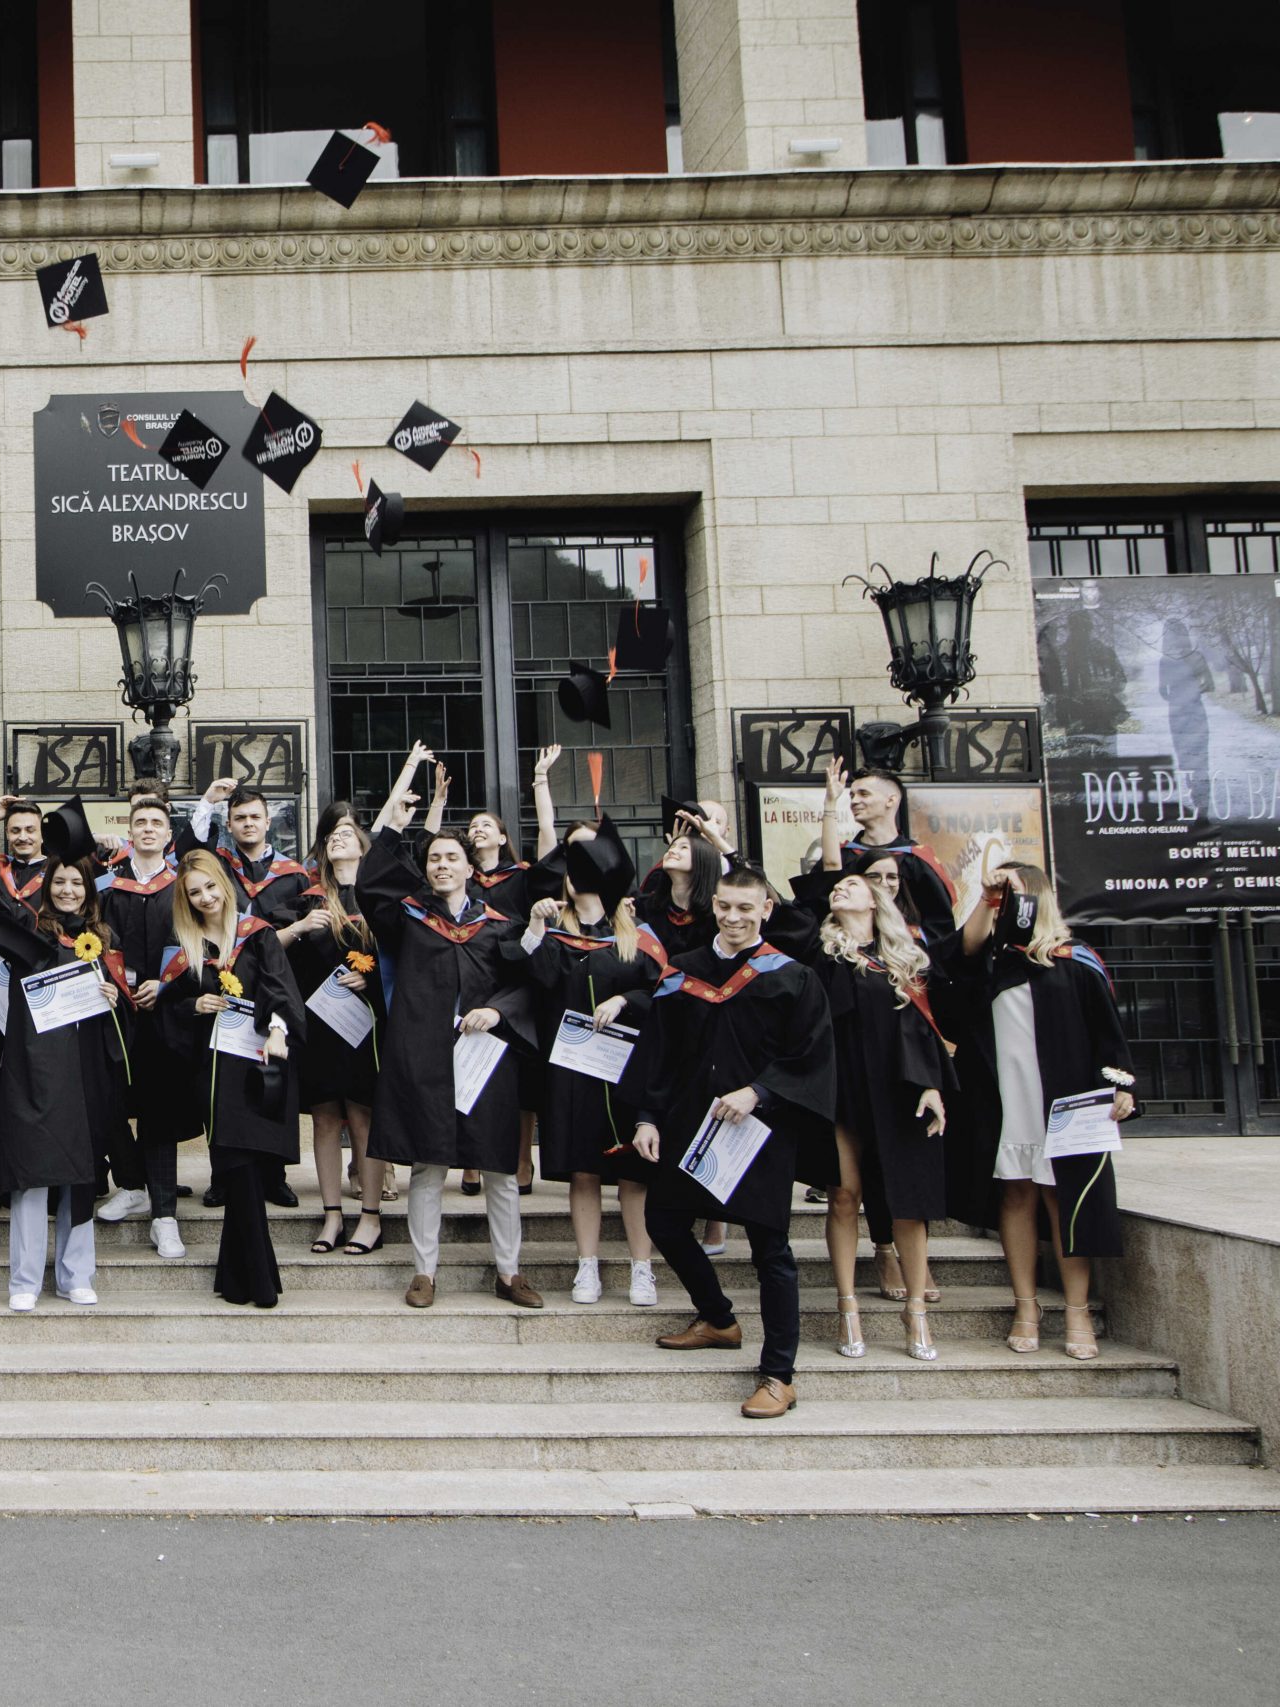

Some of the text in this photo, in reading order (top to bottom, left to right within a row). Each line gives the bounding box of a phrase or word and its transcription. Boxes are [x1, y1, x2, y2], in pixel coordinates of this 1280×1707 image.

[63, 276, 82, 304] HOTEL
[126, 413, 169, 421] CONSILIUL
[145, 422, 176, 430] BRAȘO
[266, 434, 294, 449] HOTEL
[180, 445, 205, 454] HOTEL
[256, 447, 294, 464] American
[172, 453, 205, 462] American
[51, 490, 248, 513] SICĂ ALEXANDRESCU
[112, 523, 189, 544] BRAȘOV
[749, 720, 840, 774] TSA
[203, 733, 293, 786] TSA
[1153, 770, 1198, 822] PE
[1211, 770, 1231, 820] O
[764, 811, 778, 824] LA
[928, 812, 1022, 833] O NOAPTE
[1098, 827, 1147, 835] ALEKSANDR
[1148, 826, 1188, 834] GHELMAN
[1169, 846, 1280, 859] BORIS MELIN
[1105, 878, 1169, 890] SIMONA
[1175, 877, 1209, 889] POP
